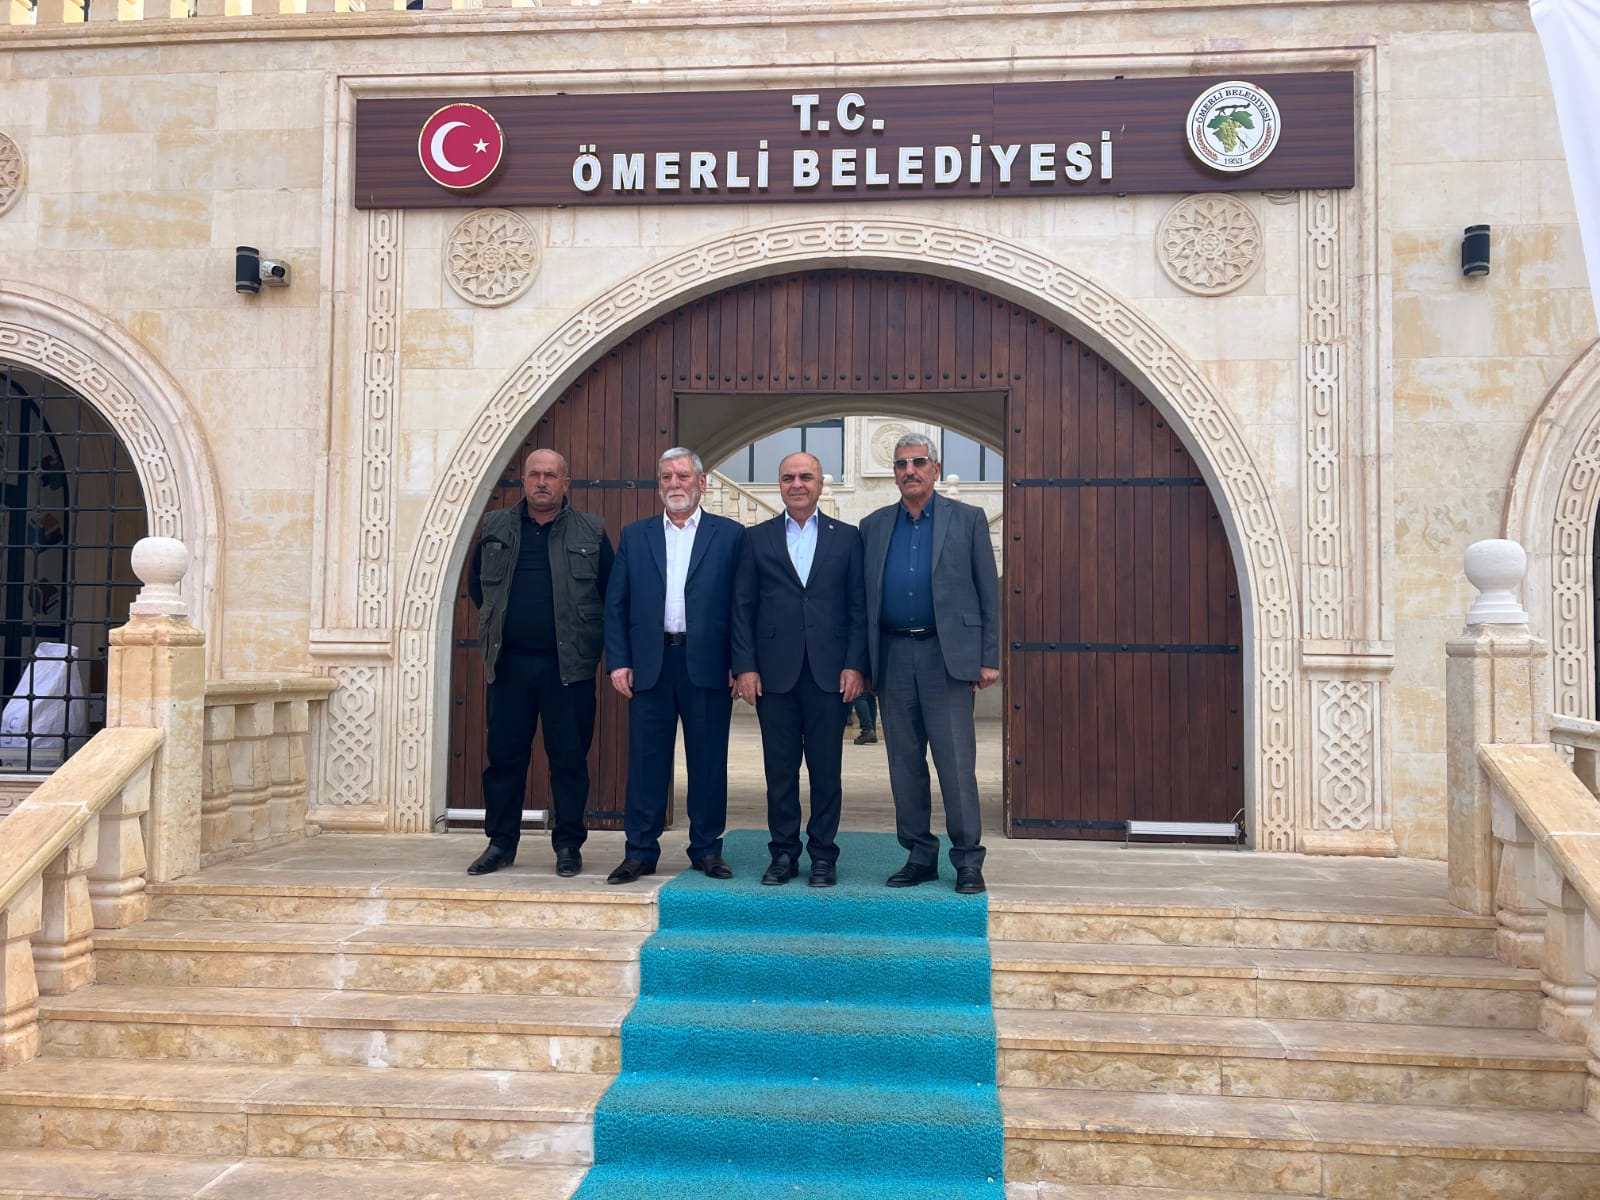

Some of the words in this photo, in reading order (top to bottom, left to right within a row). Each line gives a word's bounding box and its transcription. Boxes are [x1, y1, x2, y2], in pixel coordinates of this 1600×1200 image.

[791, 92, 885, 131] T.C.
[1225, 89, 1273, 122] BELEDİYESİ
[572, 139, 768, 192] ÖMERLİ
[792, 130, 1114, 190] BELEDİYESİ
[1224, 157, 1243, 165] 1953
